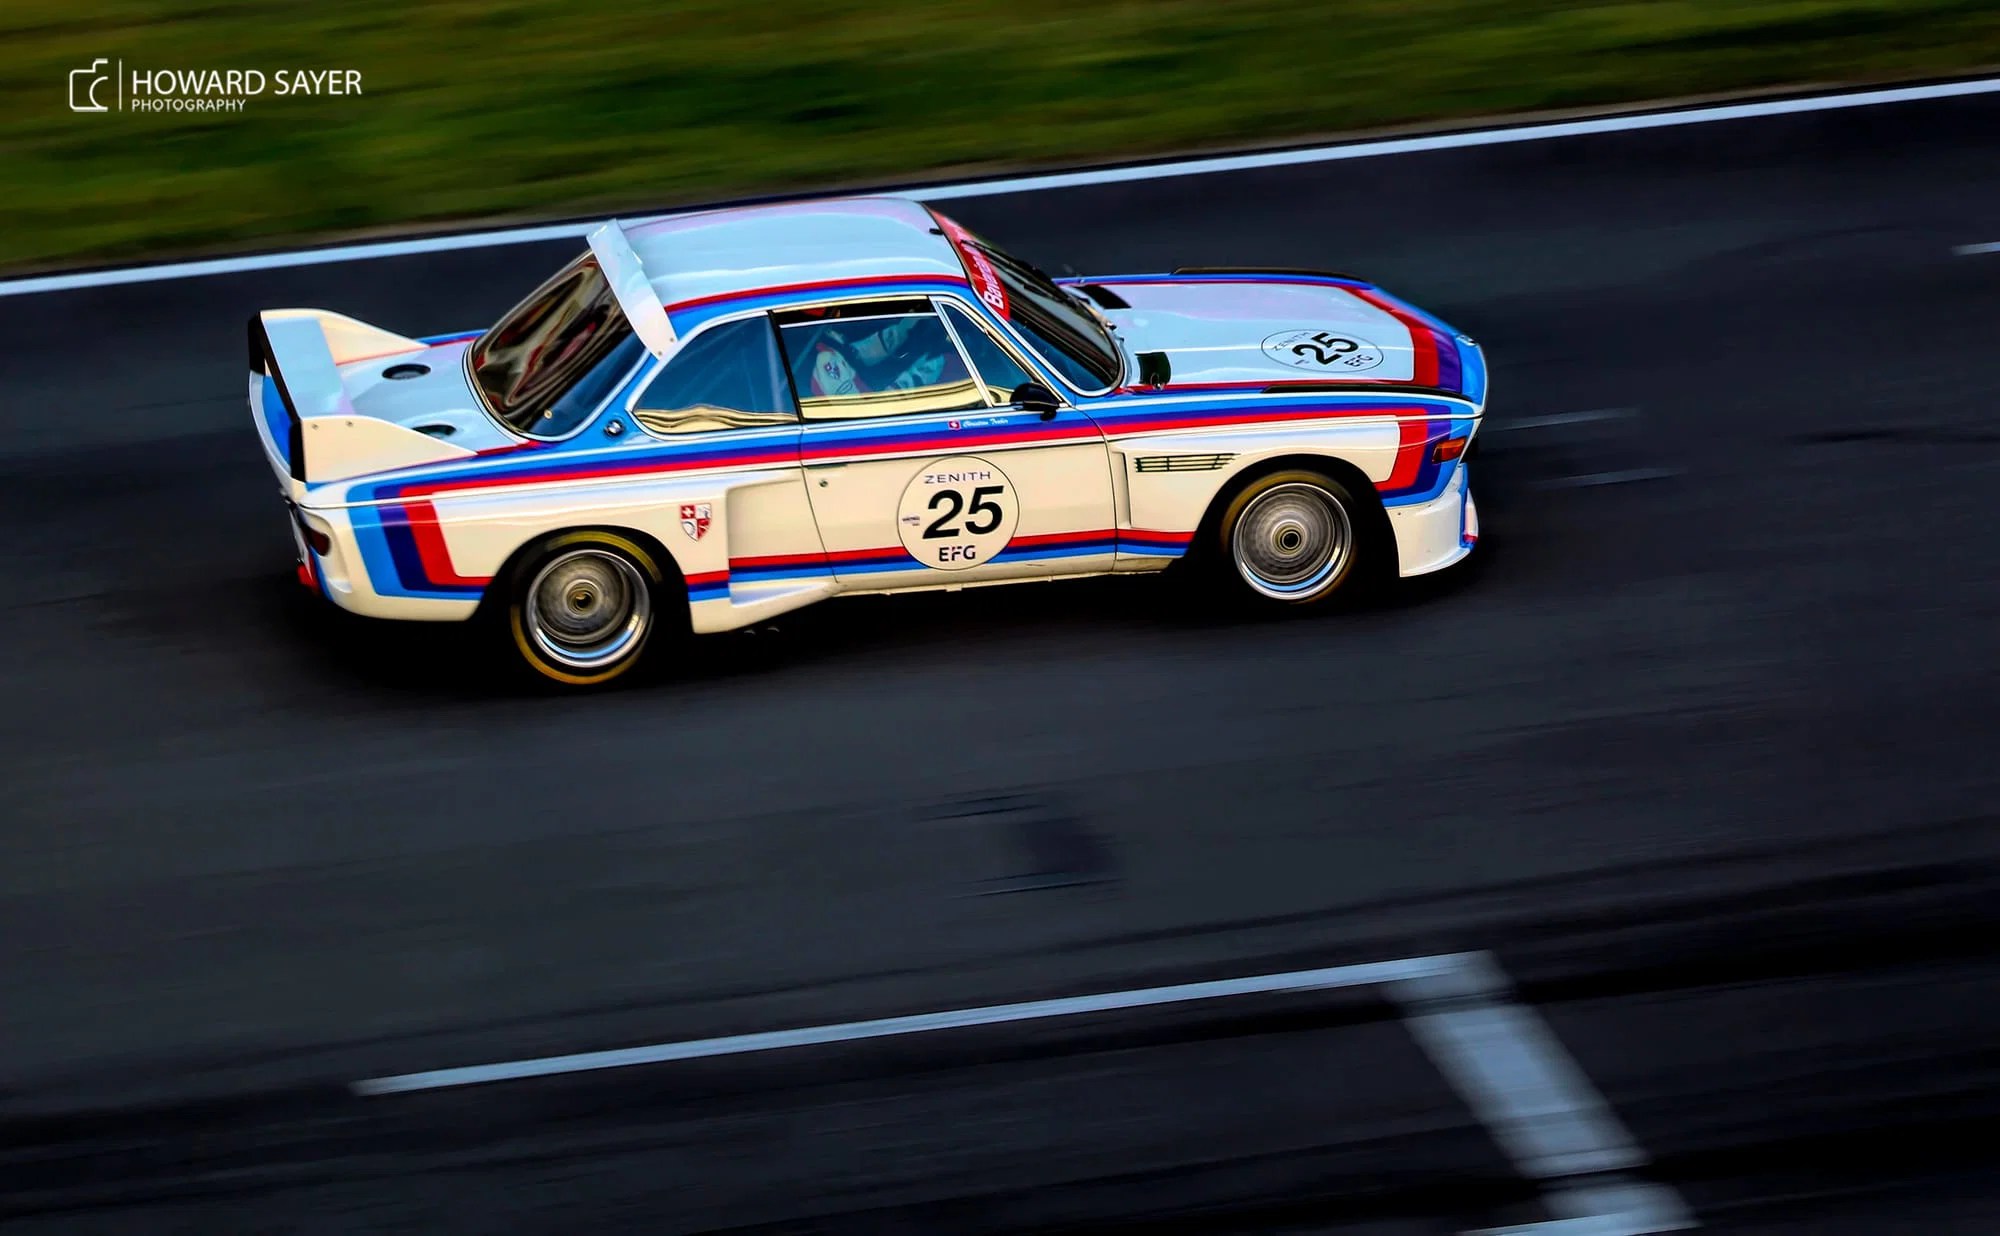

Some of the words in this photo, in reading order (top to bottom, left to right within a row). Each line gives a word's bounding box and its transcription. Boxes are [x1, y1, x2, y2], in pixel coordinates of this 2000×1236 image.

[1292, 332, 1359, 365] 25
[924, 471, 992, 484] ZENITH
[922, 485, 1004, 539] 25
[938, 545, 976, 561] EFG
